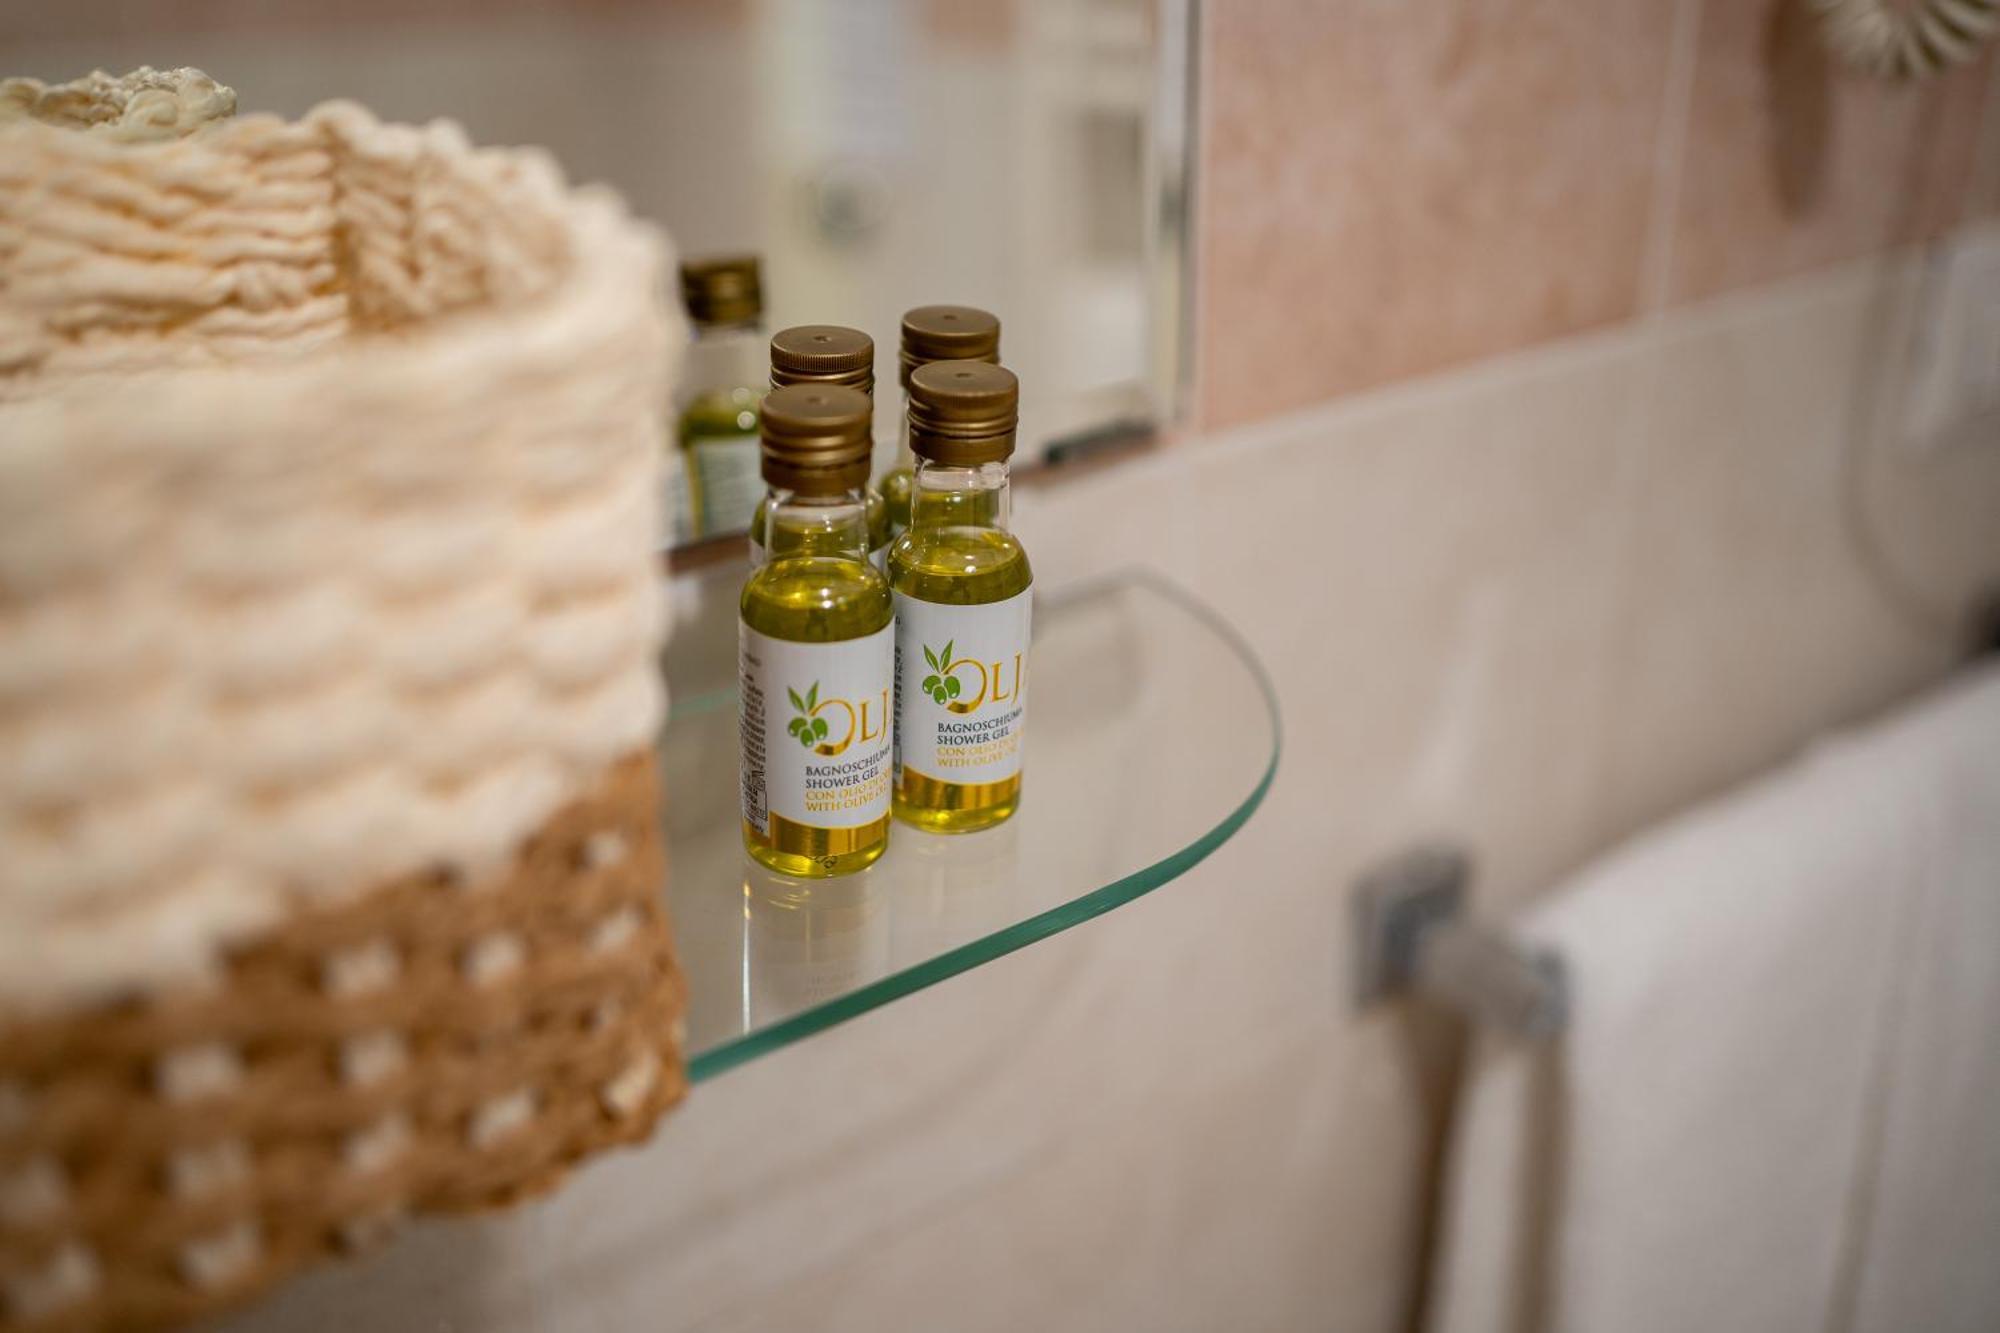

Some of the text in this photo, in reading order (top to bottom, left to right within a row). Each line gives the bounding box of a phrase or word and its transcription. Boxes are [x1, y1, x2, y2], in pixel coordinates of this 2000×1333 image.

[943, 650, 1025, 714] OLJ
[809, 687, 893, 757] OLJ
[936, 730, 990, 746] SHOWER
[992, 725, 1009, 741] GEL
[937, 746, 966, 758] CON
[937, 756, 970, 769] WITH
[805, 773, 861, 790] SHOWER
[862, 765, 880, 784] GEL
[806, 788, 836, 801] CON
[806, 798, 842, 812] WITH
